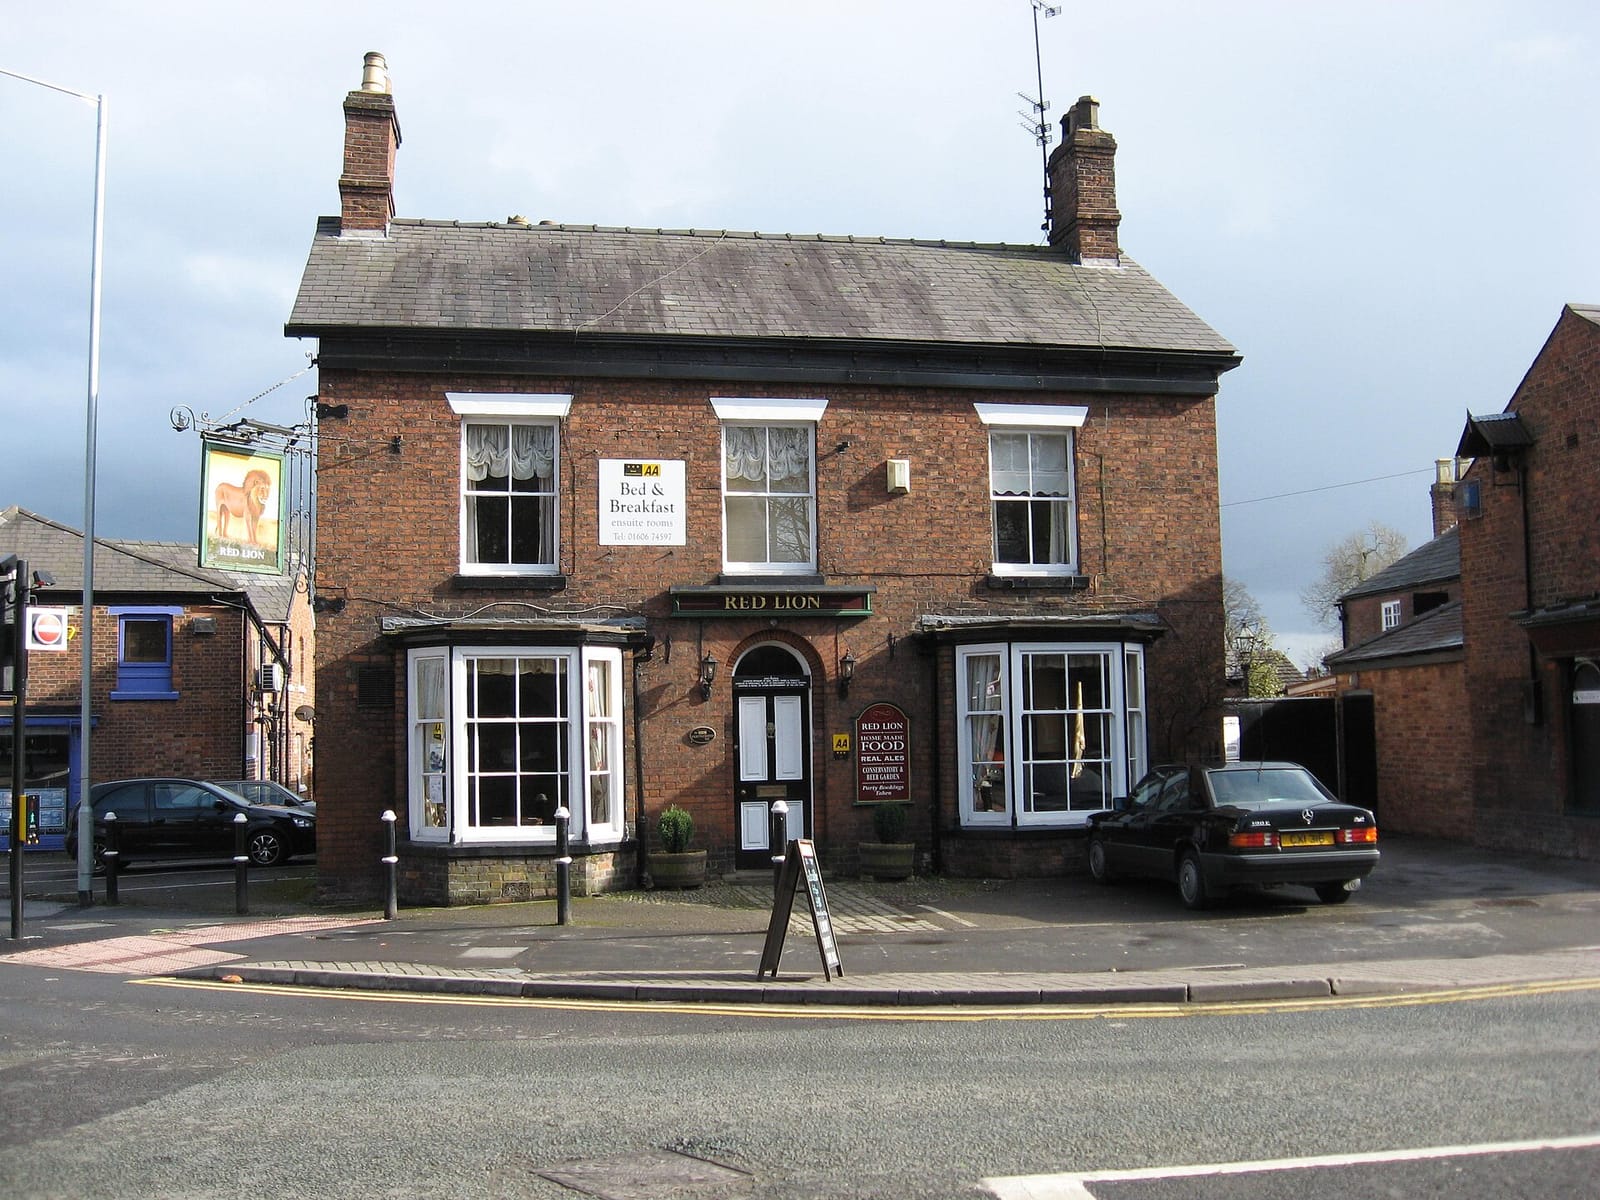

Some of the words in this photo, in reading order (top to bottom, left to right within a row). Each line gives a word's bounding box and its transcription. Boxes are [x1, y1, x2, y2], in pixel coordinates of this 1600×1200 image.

[643, 465, 660, 476] AA
[620, 482, 646, 496] Bed
[651, 482, 665, 496] &
[609, 499, 675, 514] Breakfast
[611, 518, 644, 527] ensuite
[613, 532, 626, 541] Tel:
[627, 532, 650, 541] 01606
[651, 532, 672, 541] 74597
[220, 546, 240, 557] RED
[242, 549, 265, 560] LION
[724, 595, 767, 610] RED
[773, 595, 821, 610] LION
[861, 722, 880, 730] RED
[882, 722, 904, 730] LION
[835, 739, 848, 748] AA
[861, 741, 905, 751] FOOD
